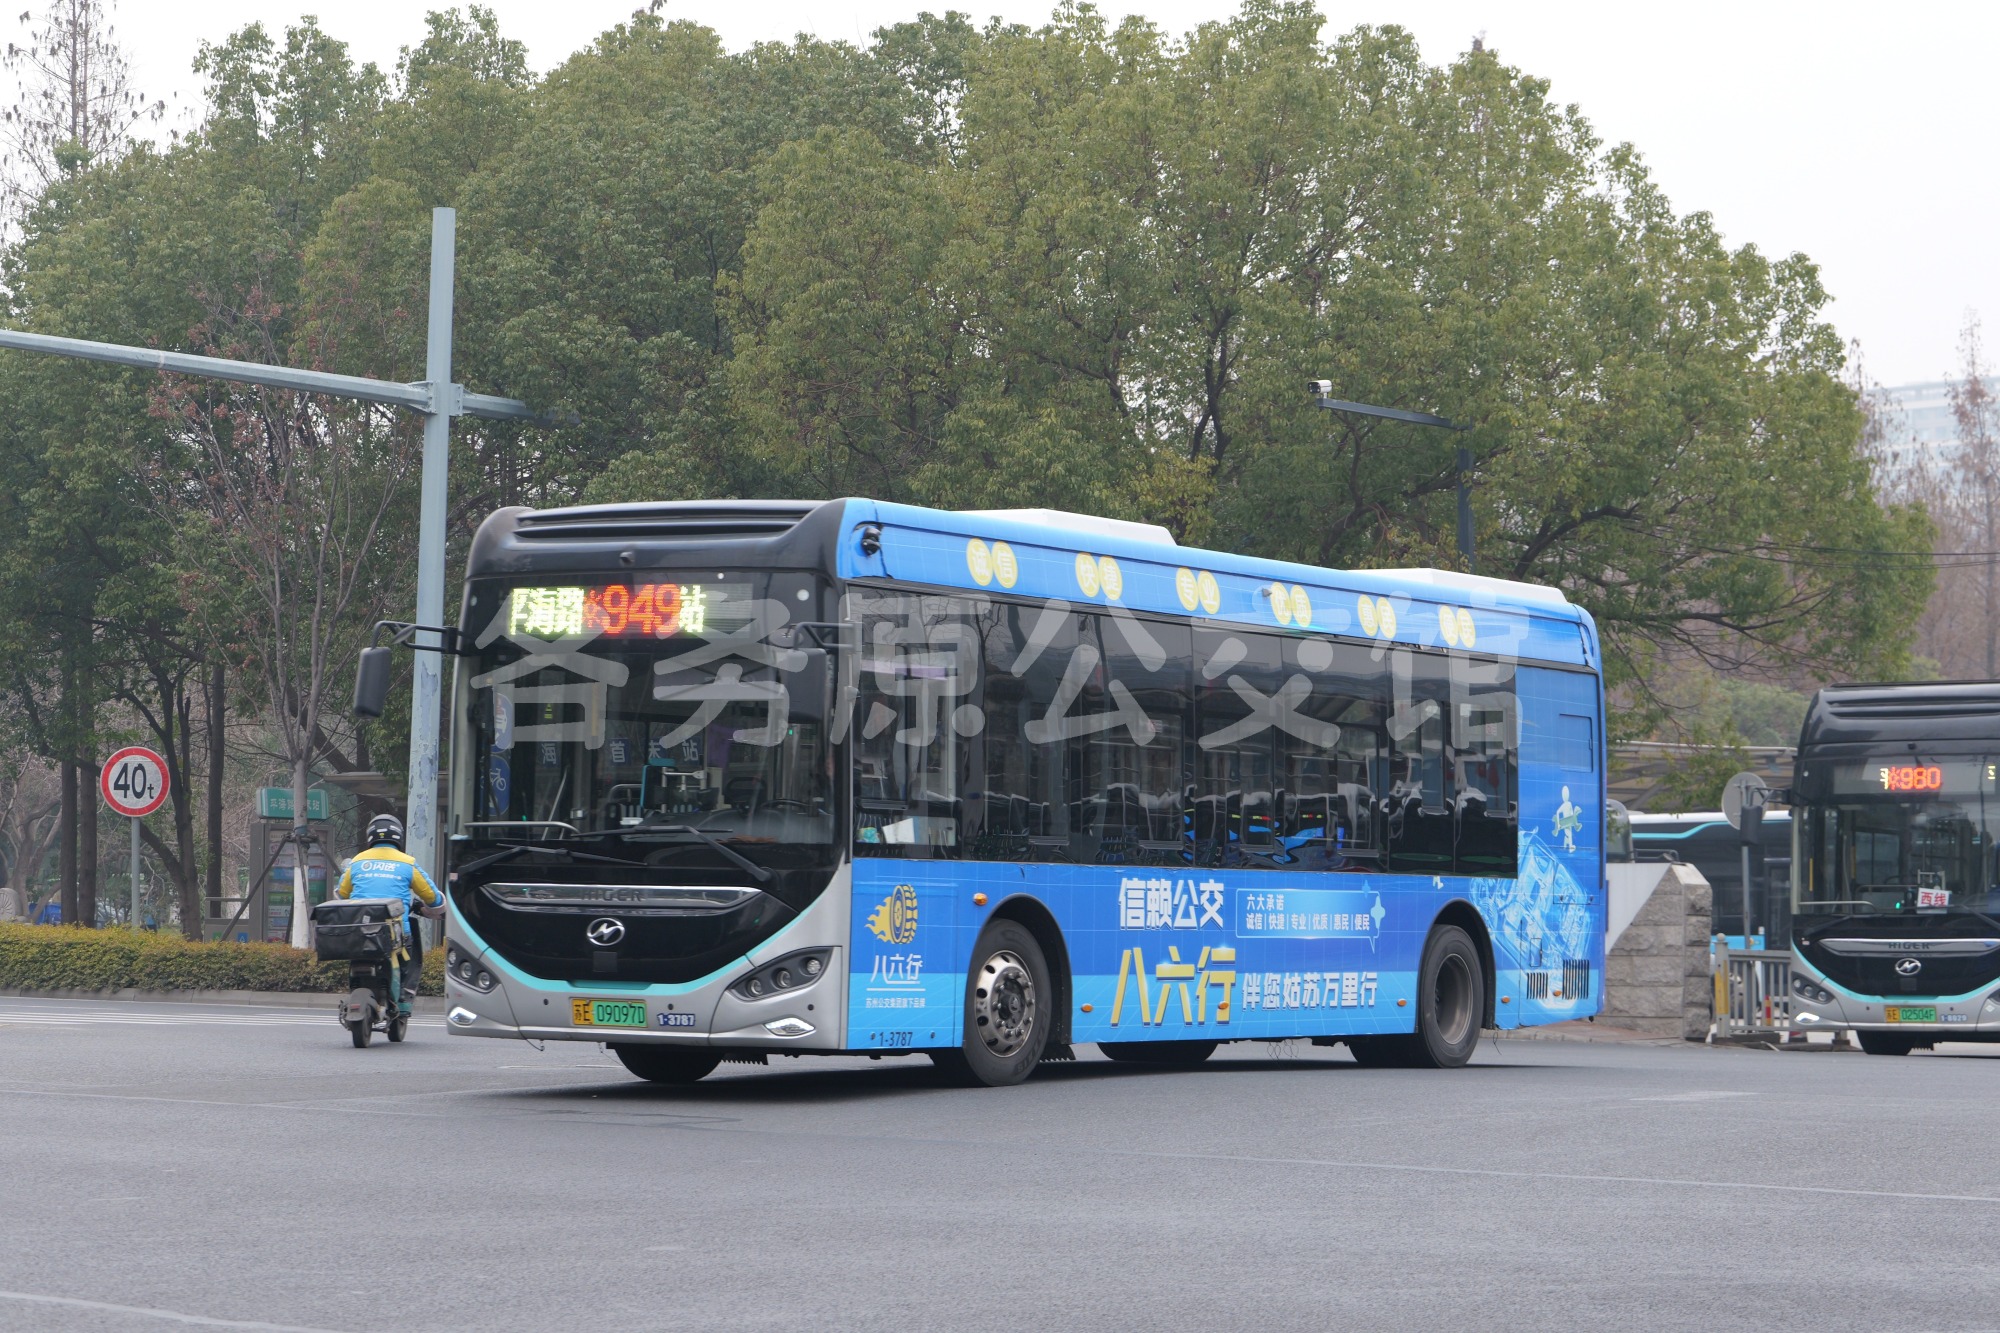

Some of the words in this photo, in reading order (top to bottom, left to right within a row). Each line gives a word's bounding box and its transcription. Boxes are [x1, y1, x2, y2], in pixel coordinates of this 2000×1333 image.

[972, 549, 1013, 579] 诚信
[1080, 560, 1120, 590] 快捷
[1181, 575, 1217, 606] 专业
[1275, 590, 1308, 620] 优质
[1119, 878, 1225, 931] 信赖公交
[1246, 894, 1285, 911] 六大承诺
[1921, 891, 1948, 907] 西线
[1246, 913, 1263, 930] 诚信
[1268, 914, 1285, 930] 快捷
[1291, 914, 1307, 930] 专业
[1313, 914, 1328, 930] 优质
[1334, 914, 1349, 930] 惠民
[1355, 914, 1370, 930] 便民
[870, 953, 924, 985] 八六行
[1110, 946, 1236, 1028] 八六行
[1242, 972, 1378, 1011] 伴您姑苏万里行
[597, 1004, 646, 1024] 09097D
[1901, 1008, 1936, 1021] 02504F
[879, 1031, 914, 1047] 1-3787
